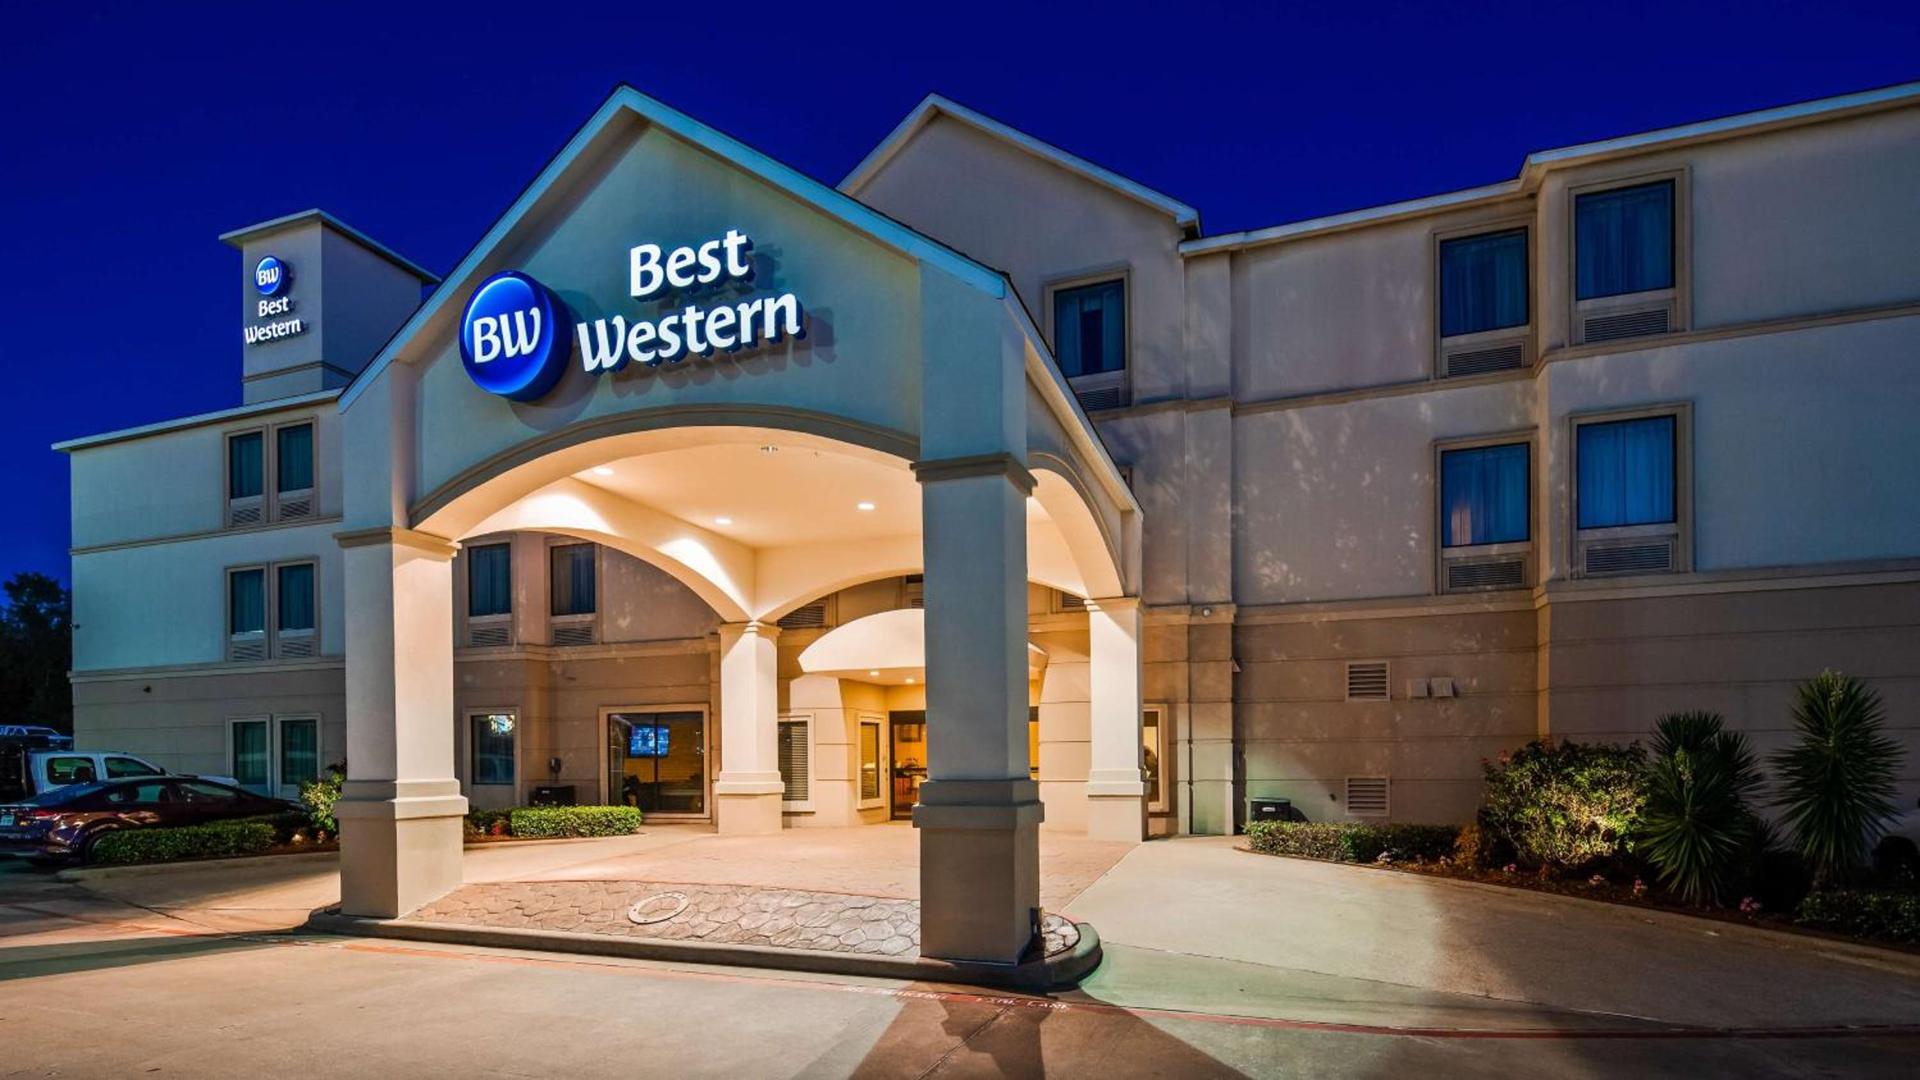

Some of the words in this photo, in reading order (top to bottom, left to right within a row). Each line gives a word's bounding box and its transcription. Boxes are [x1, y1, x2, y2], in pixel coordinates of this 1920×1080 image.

[258, 267, 279, 286] BW
[629, 229, 750, 298] Best
[259, 296, 289, 317] Best
[244, 318, 301, 344] Western
[472, 306, 542, 364] BW
[576, 292, 802, 373] Western
